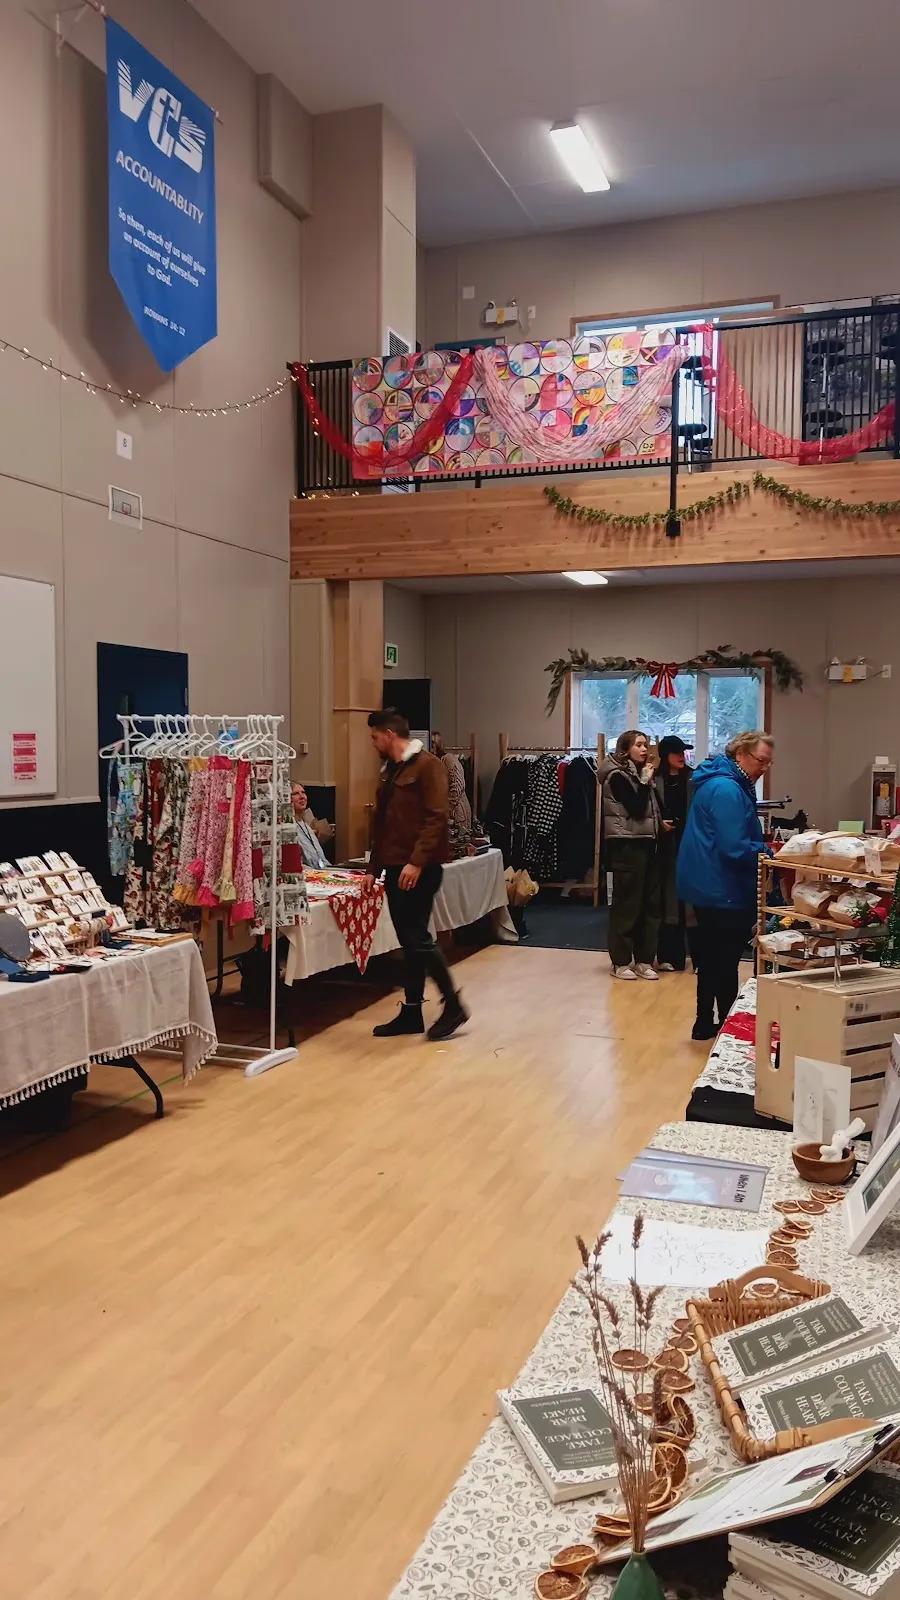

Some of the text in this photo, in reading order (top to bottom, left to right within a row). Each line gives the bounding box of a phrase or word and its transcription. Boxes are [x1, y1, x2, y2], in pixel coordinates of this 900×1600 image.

[115, 150, 204, 224] ACCOUNTABLITY
[118, 206, 206, 275] So then, each of us will give
[123, 231, 199, 287] an account of ourselves
[147, 263, 172, 286] to God.
[792, 1317, 818, 1348] COURAGE
[809, 1317, 827, 1336] TAKE
[758, 1335, 778, 1358] HEART
[771, 1332, 789, 1352] DEAR
[853, 1378, 874, 1406] TAKE
[542, 1406, 586, 1419] HEART
[795, 1395, 818, 1425] HEART
[810, 1393, 831, 1420] DEAR
[551, 1414, 588, 1426] DEAR
[545, 1427, 612, 1443] COURAGE
[565, 1437, 604, 1449] TAKE
